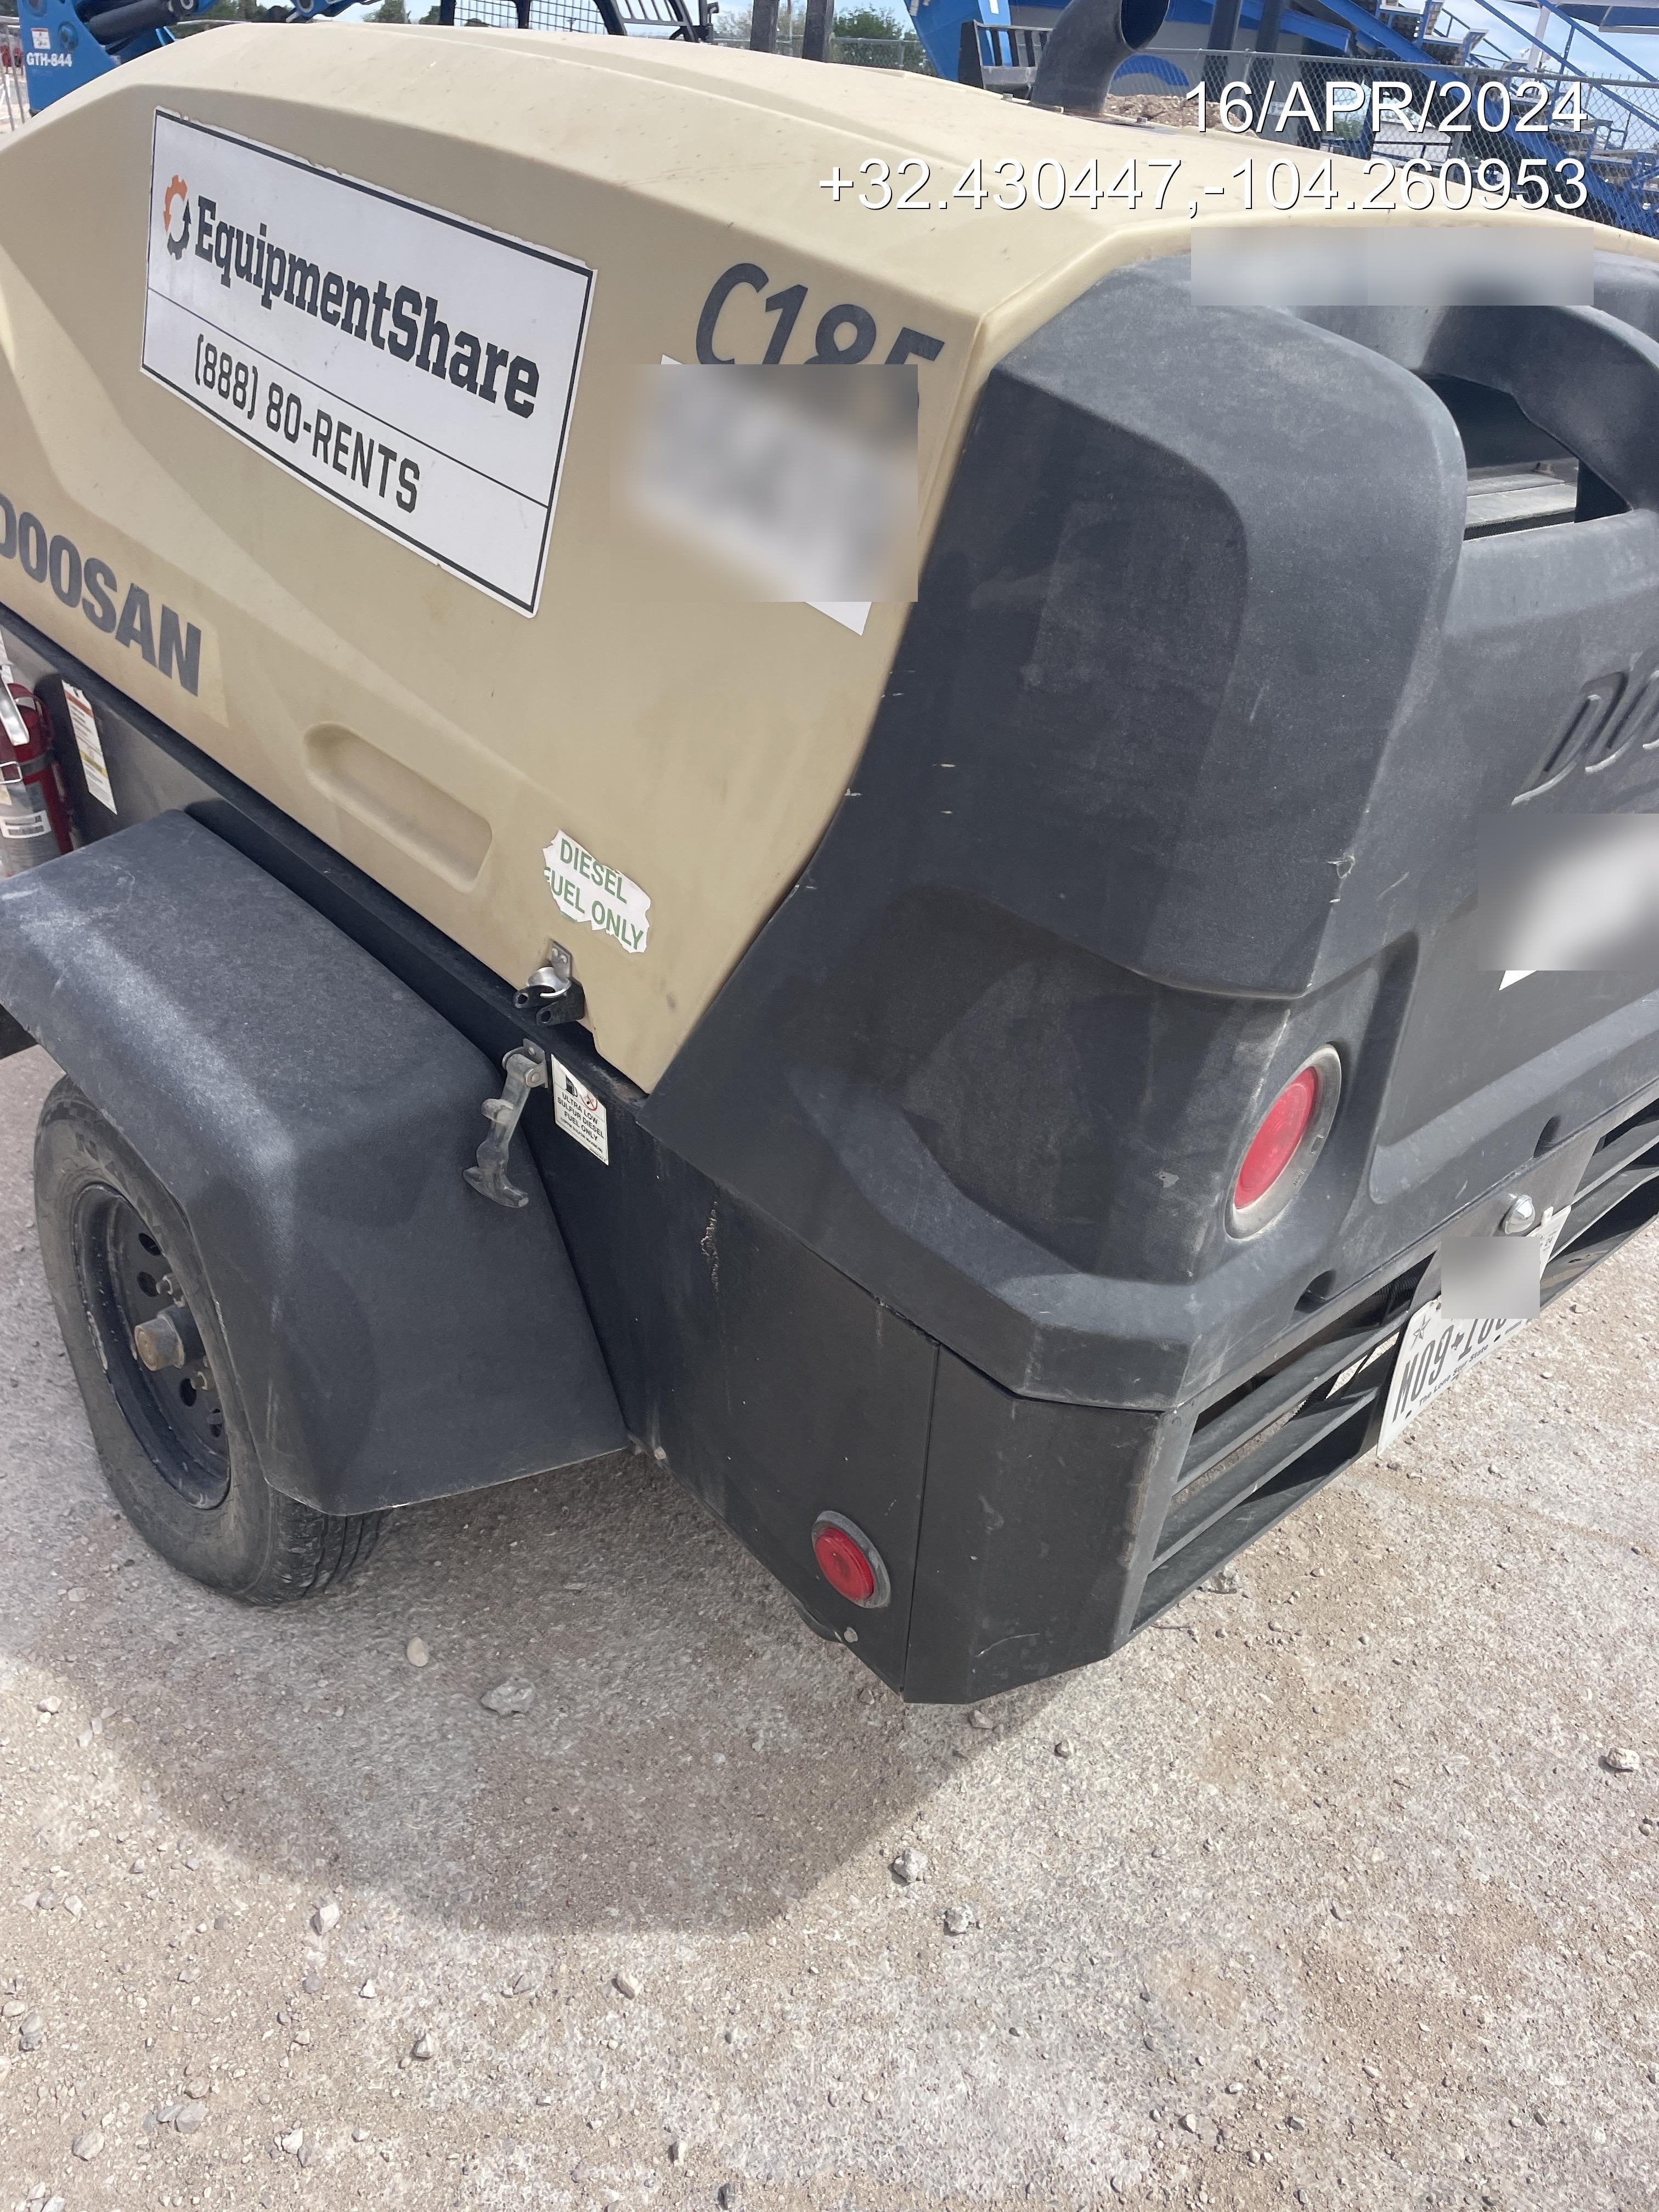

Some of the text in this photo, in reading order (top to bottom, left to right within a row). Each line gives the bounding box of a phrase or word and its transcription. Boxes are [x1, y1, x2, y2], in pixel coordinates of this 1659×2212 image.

[26, 52, 72, 67] GTH-844
[195, 195, 540, 419] EquipmentShare
[195, 333, 420, 514] (888) 80-RENTS
[560, 838, 627, 905] DIESEL
[591, 900, 644, 950] ONLY
[557, 1097, 582, 1119] SULFUR
[583, 1116, 605, 1139] DIESEL
[562, 1092, 598, 1125] ULTRA LOW
[564, 1110, 580, 1128] FUEL
[581, 1125, 598, 1142] ONLY
